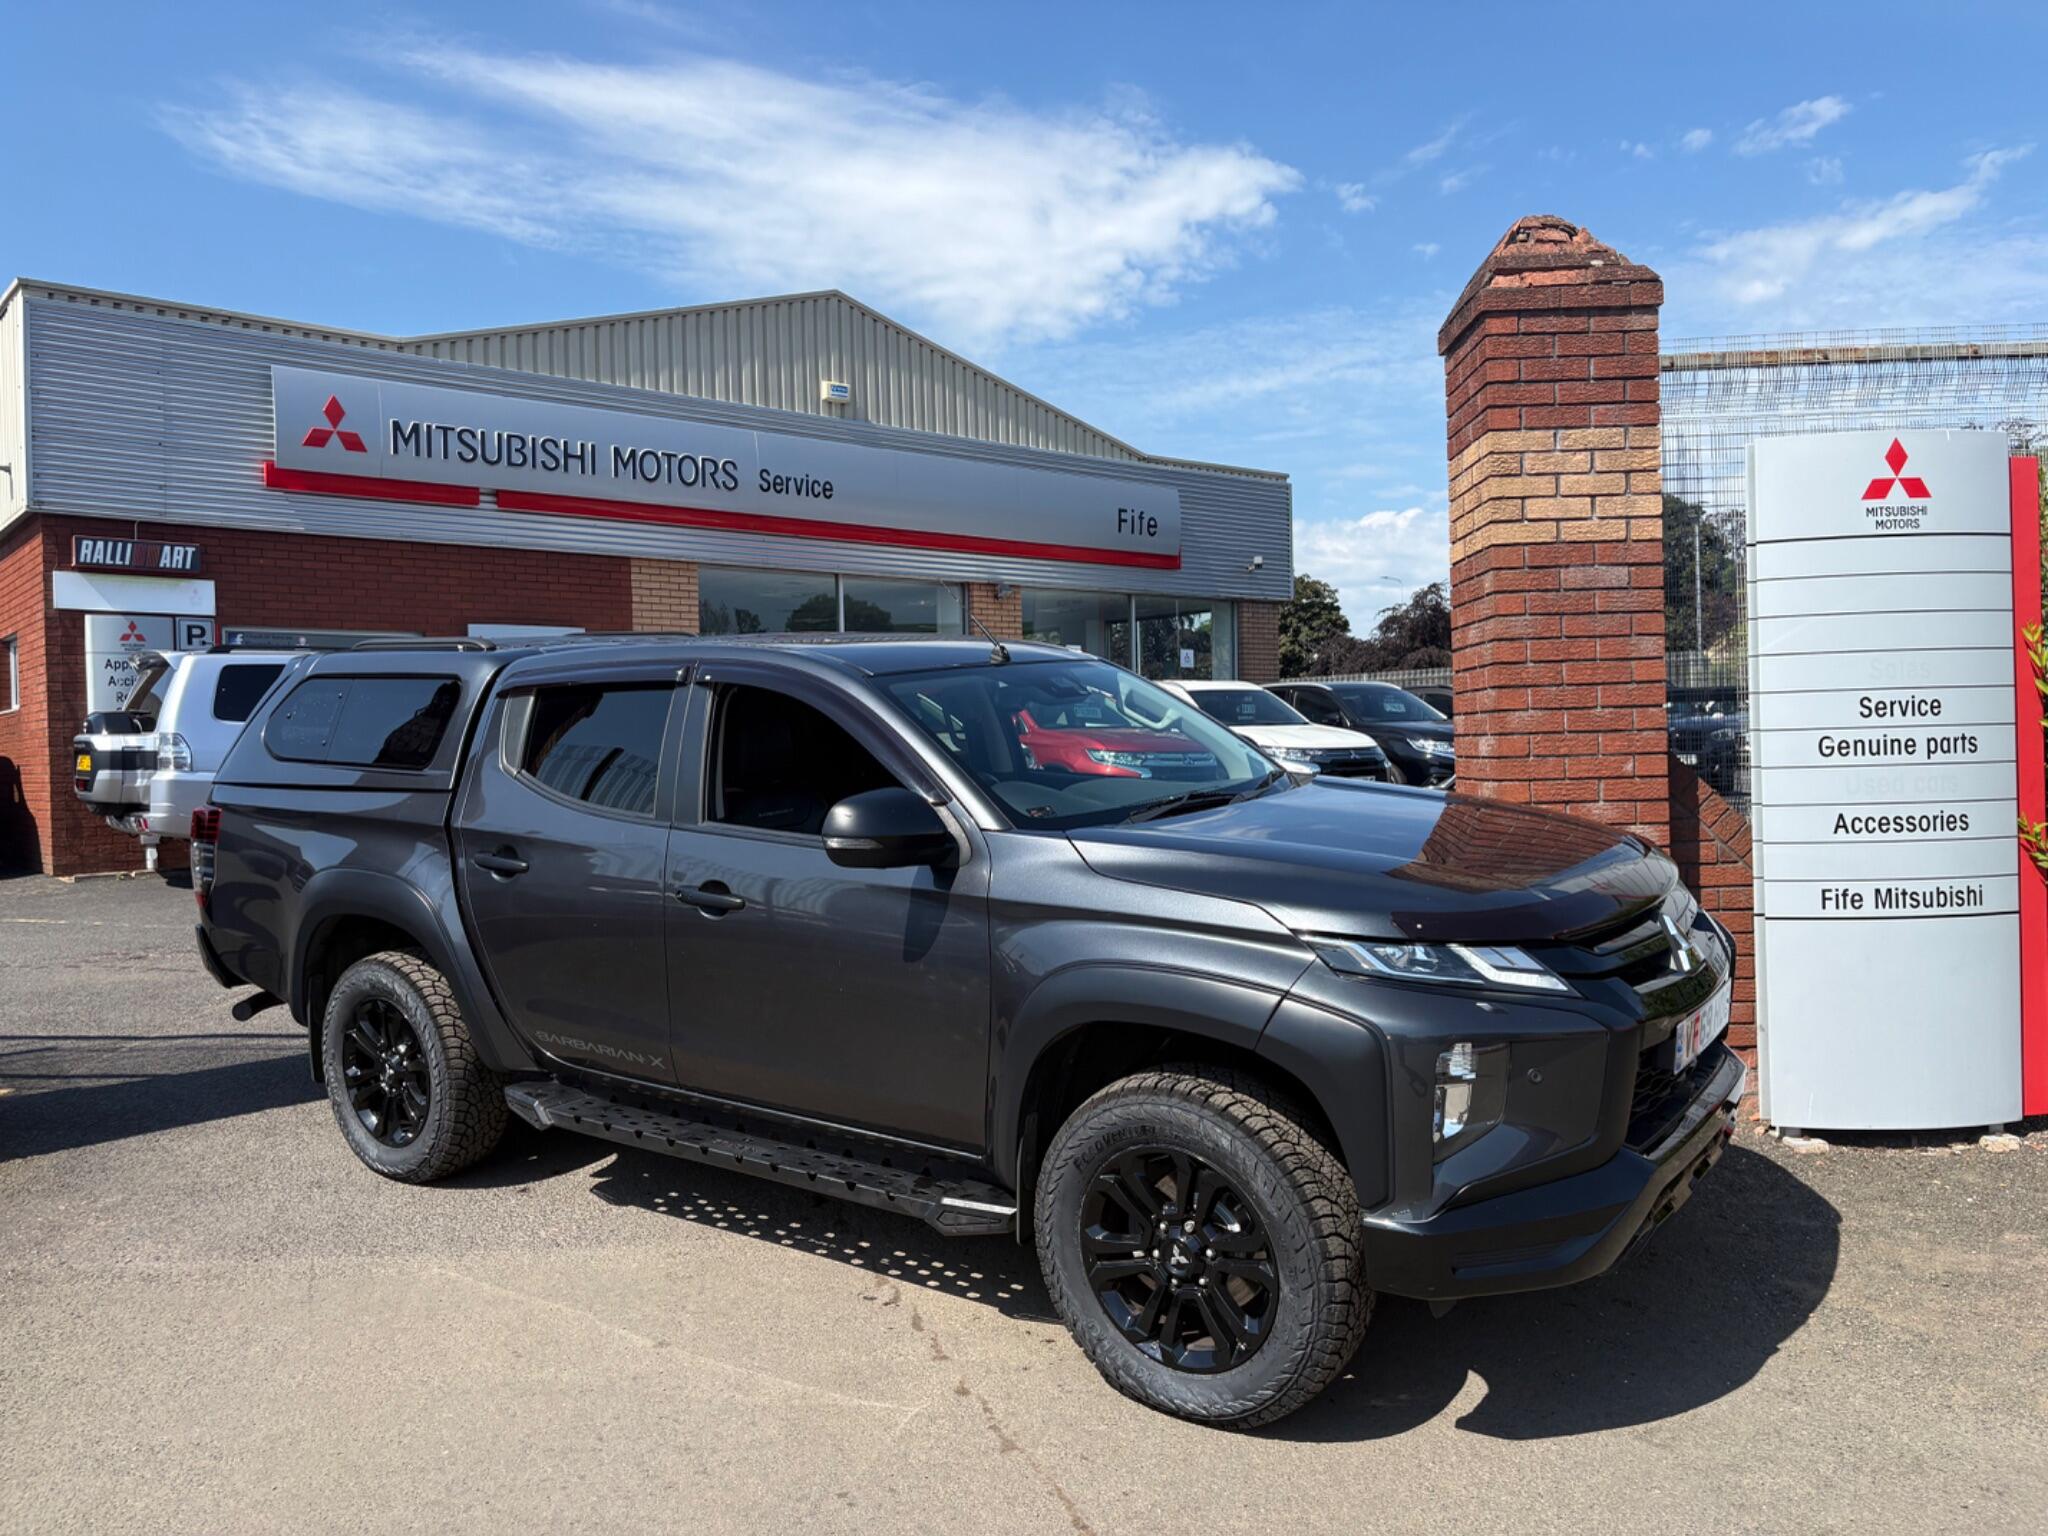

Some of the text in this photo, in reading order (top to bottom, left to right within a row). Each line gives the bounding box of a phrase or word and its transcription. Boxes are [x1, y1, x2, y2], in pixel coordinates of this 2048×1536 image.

[390, 418, 834, 500] MITSUBISHI MOTORS Service
[1117, 507, 1158, 537] Fife
[1866, 505, 1928, 518] MITSUBISHI
[1875, 518, 1920, 530] MOTORS
[186, 624, 206, 646] P
[1859, 695, 1942, 718] Service
[1818, 732, 1978, 760] Genuine parts
[1833, 810, 1970, 834] Accessories
[1821, 884, 1984, 911] Fife Mitsubishi
[535, 1030, 667, 1070] BARBARIAN X
